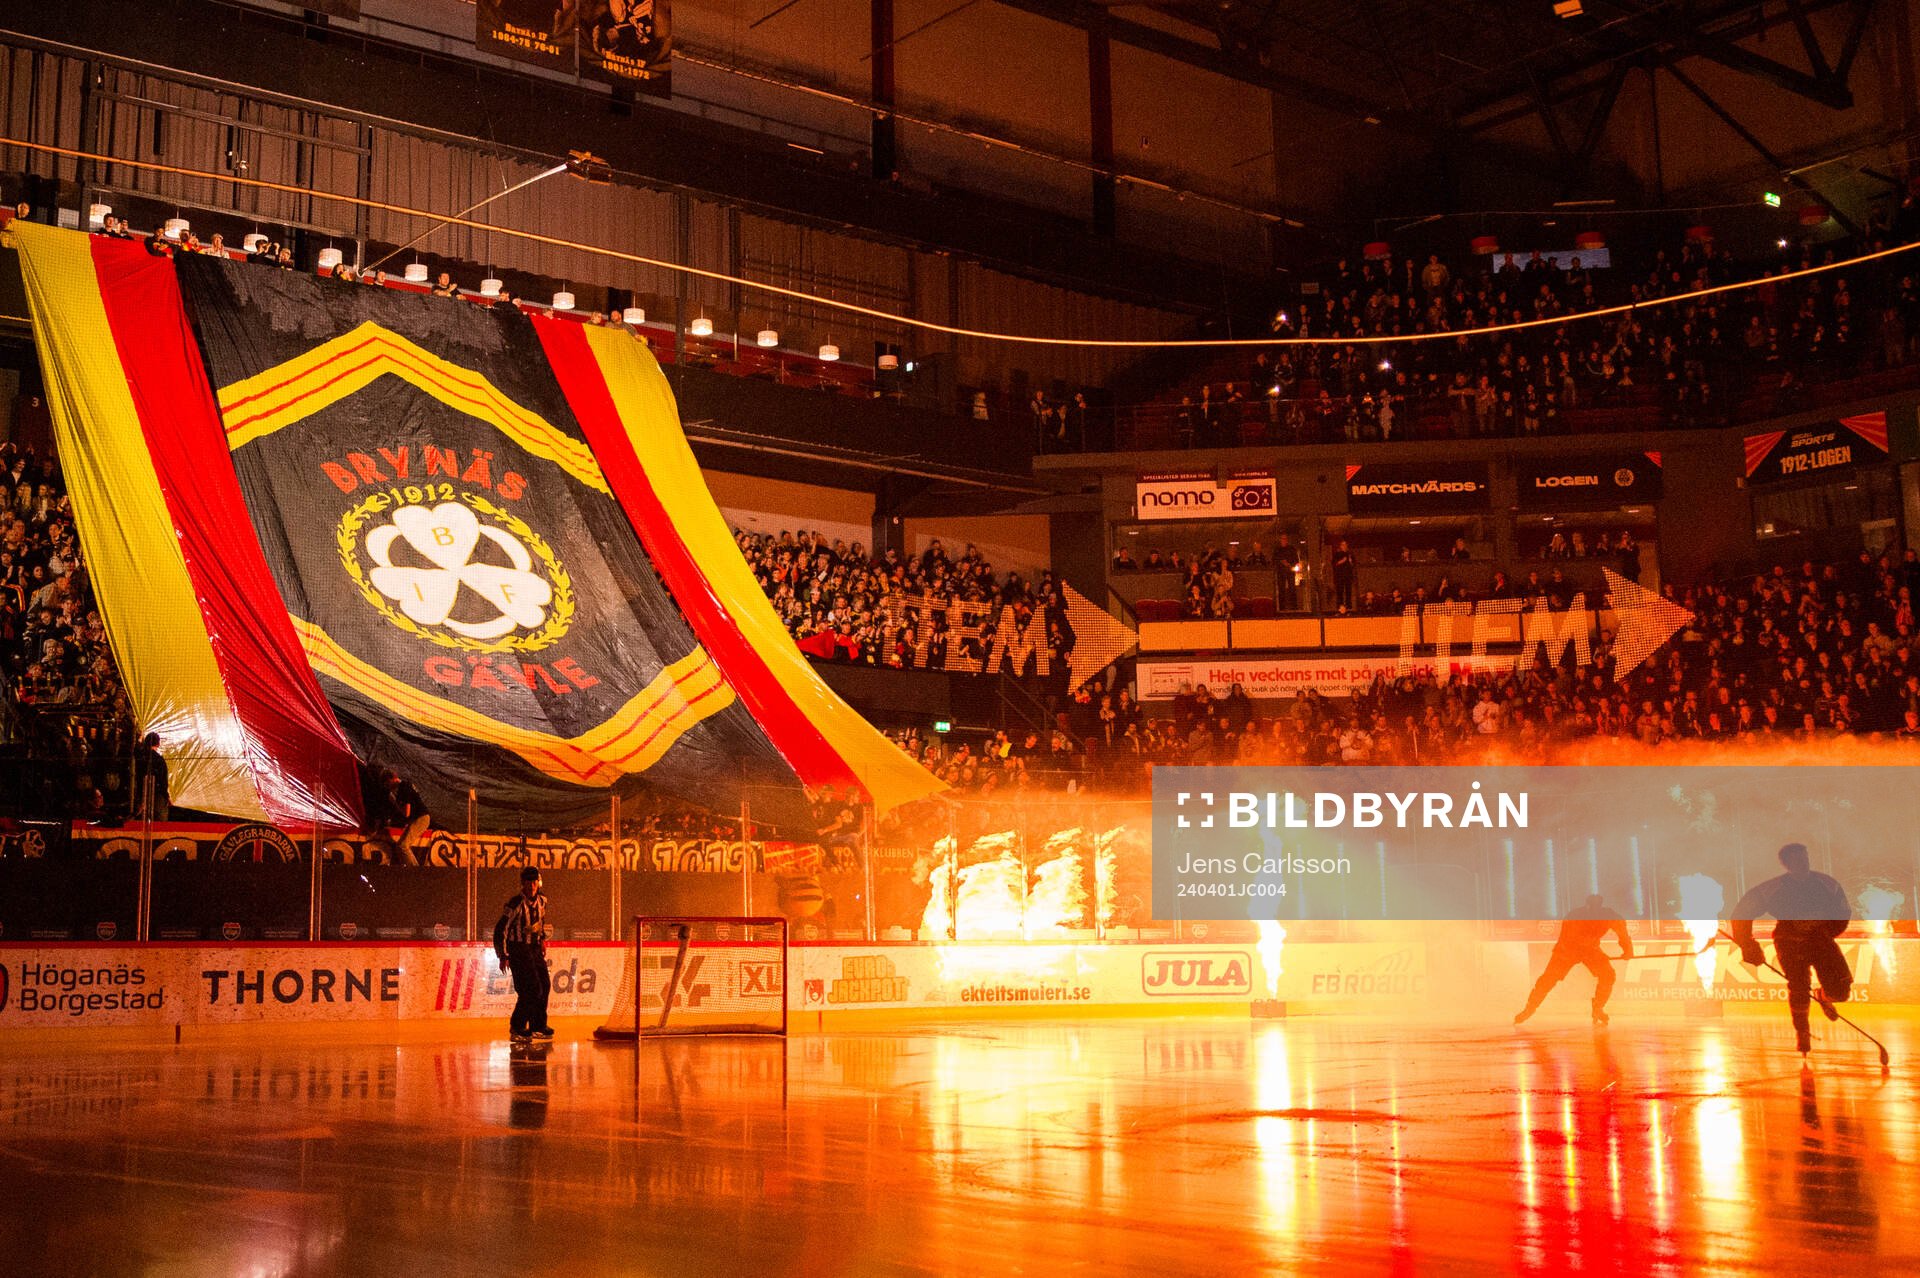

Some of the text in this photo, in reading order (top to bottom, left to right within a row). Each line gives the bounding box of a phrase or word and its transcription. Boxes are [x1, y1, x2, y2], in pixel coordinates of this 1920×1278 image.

[320, 445, 527, 500] BRYNÄS
[1780, 445, 1852, 474] 1912-LOGEN
[390, 483, 456, 505] 1912
[1351, 480, 1477, 495] MATCHVÄRDS
[1535, 475, 1599, 488] LOGEN
[1142, 490, 1215, 507] nomo
[432, 526, 455, 546] B
[423, 655, 601, 694] GÄVLE
[1209, 667, 1246, 683] Hela
[1249, 667, 1312, 683] veckans
[1315, 666, 1347, 681] mat
[1351, 663, 1371, 685] på
[21, 963, 146, 991] Höganäs
[201, 968, 400, 1004] THORNE
[743, 966, 781, 993] XL
[1147, 959, 1247, 987] JULA
[20, 988, 164, 1016] Borgestad
[1624, 987, 1658, 1001] HIGH
